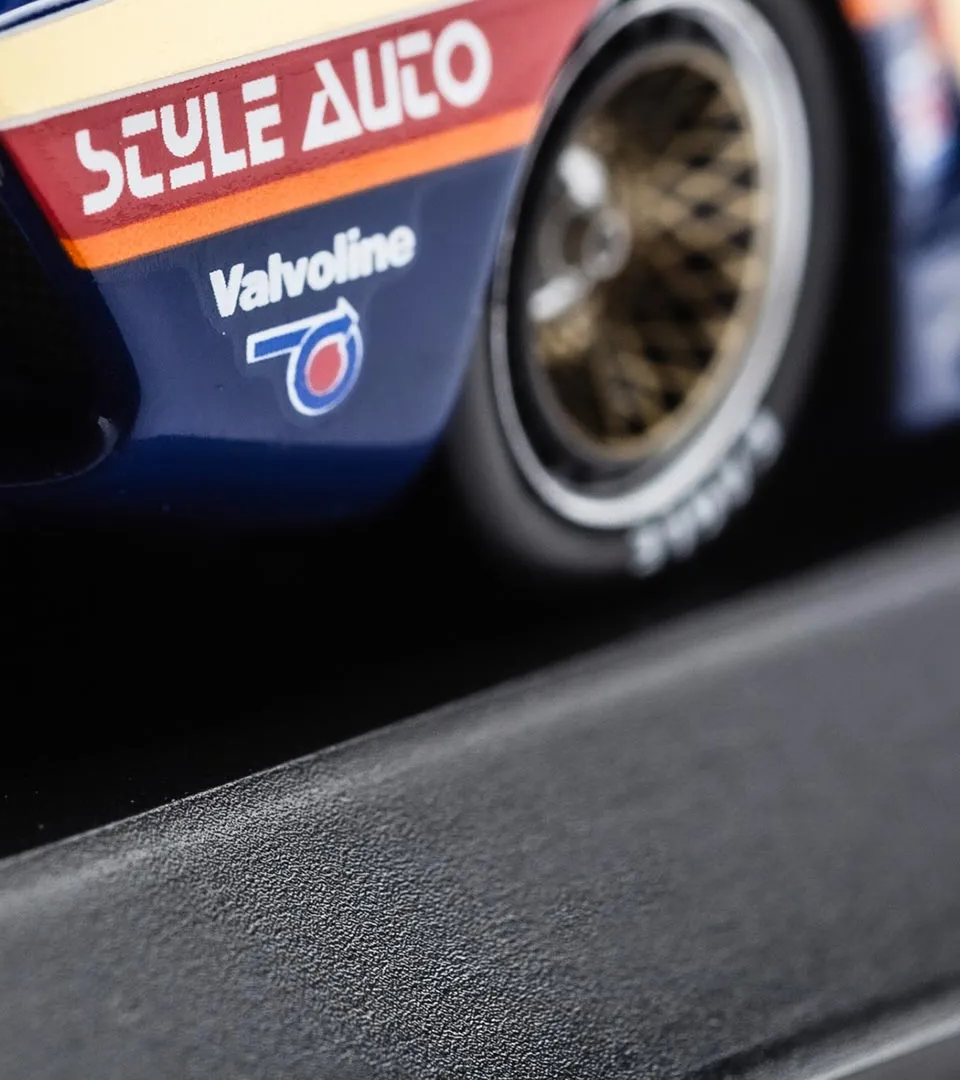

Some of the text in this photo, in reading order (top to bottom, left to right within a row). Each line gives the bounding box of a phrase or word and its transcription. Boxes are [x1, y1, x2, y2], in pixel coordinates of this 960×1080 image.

[75, 19, 493, 216] STYLE AUTO
[209, 225, 416, 318] Valvoline
